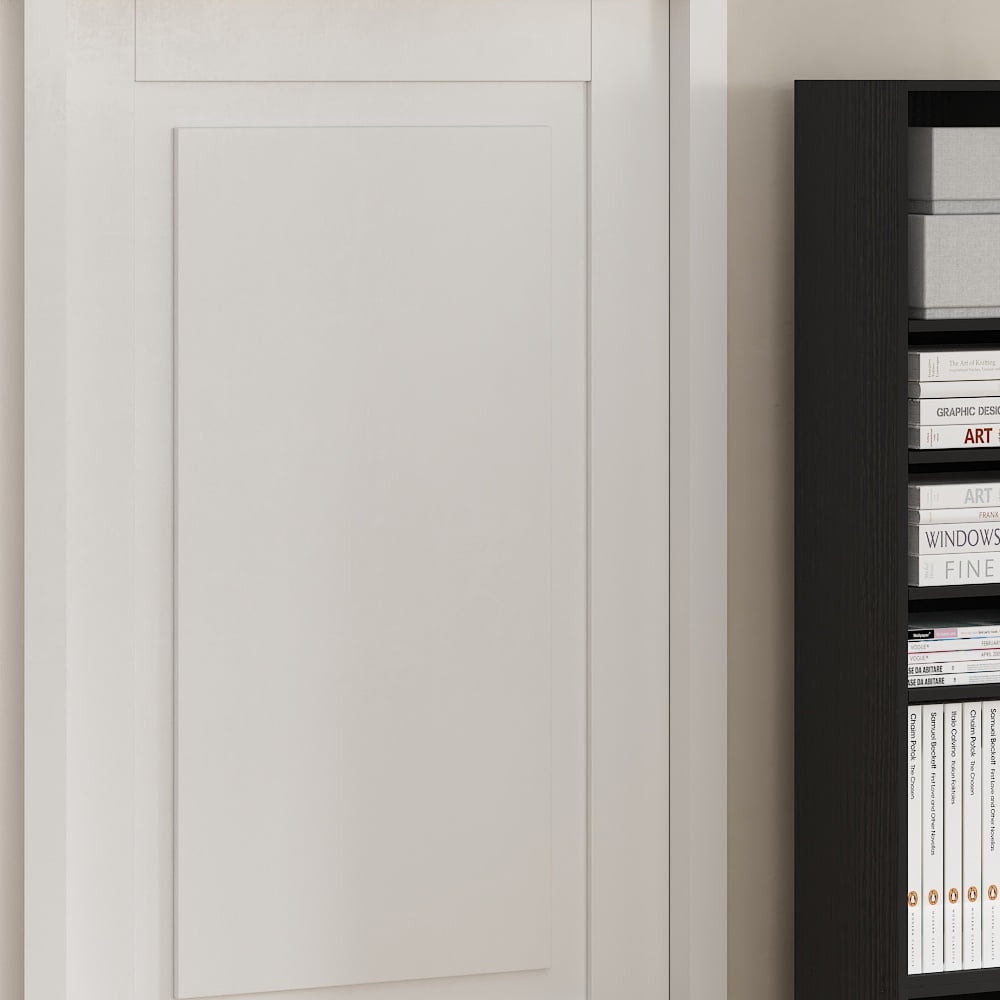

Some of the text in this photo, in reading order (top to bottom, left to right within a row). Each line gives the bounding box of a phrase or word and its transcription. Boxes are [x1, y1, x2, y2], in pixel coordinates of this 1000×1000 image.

[936, 406, 976, 417] GRAPHIC
[964, 427, 993, 444] ART
[964, 488, 993, 504] ART
[979, 511, 999, 519] FRANK
[925, 528, 1000, 549] WINDOWS
[945, 559, 995, 579] FINE
[922, 665, 943, 673] ABITARE
[924, 677, 945, 685] ABITARE
